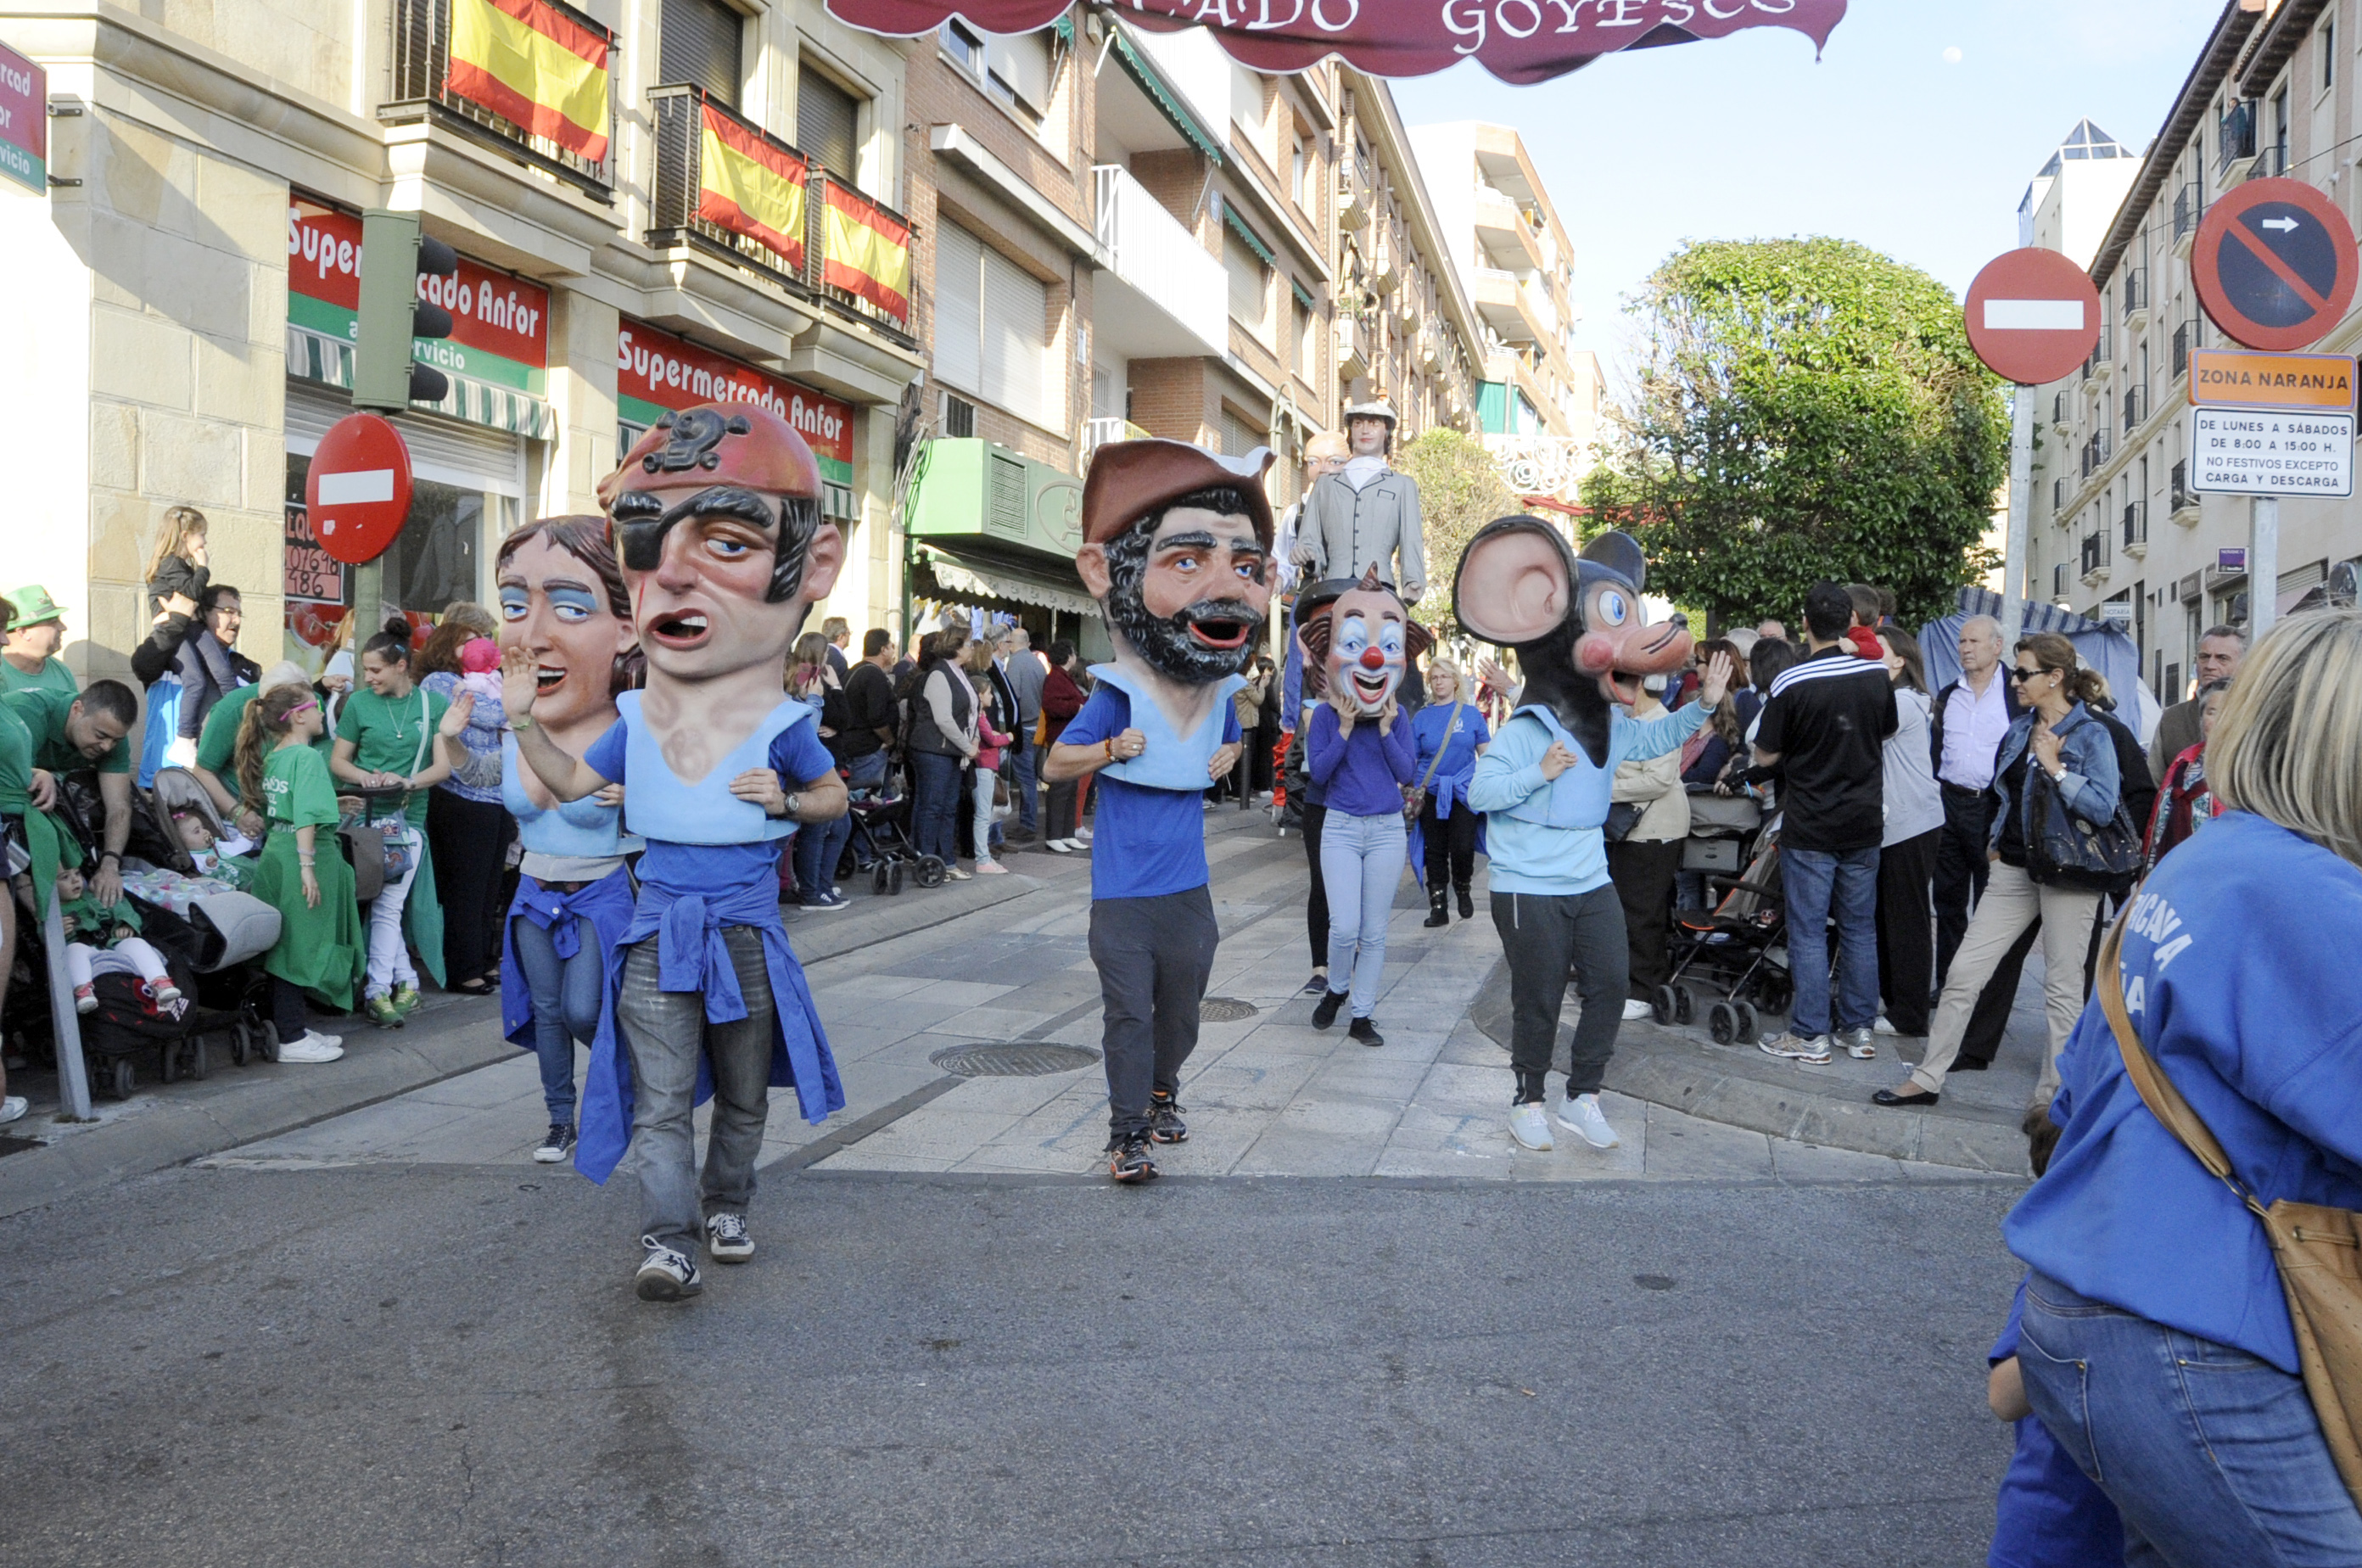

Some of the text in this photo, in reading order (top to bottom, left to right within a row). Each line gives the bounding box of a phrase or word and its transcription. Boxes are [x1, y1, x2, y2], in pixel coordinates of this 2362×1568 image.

[478, 279, 539, 338] Anfor
[2200, 369, 2348, 389] ZONA NARANJA
[791, 394, 843, 441] Anfor
[2200, 420, 2348, 434] DE LUNES A SÁBADOS
[2211, 438, 2337, 452] DE 8:00 A 15:00 H.
[2207, 456, 2338, 471] NO FESTIVOS EXCEPTO
[2206, 473, 2338, 487] CARGA Y DESCARGA
